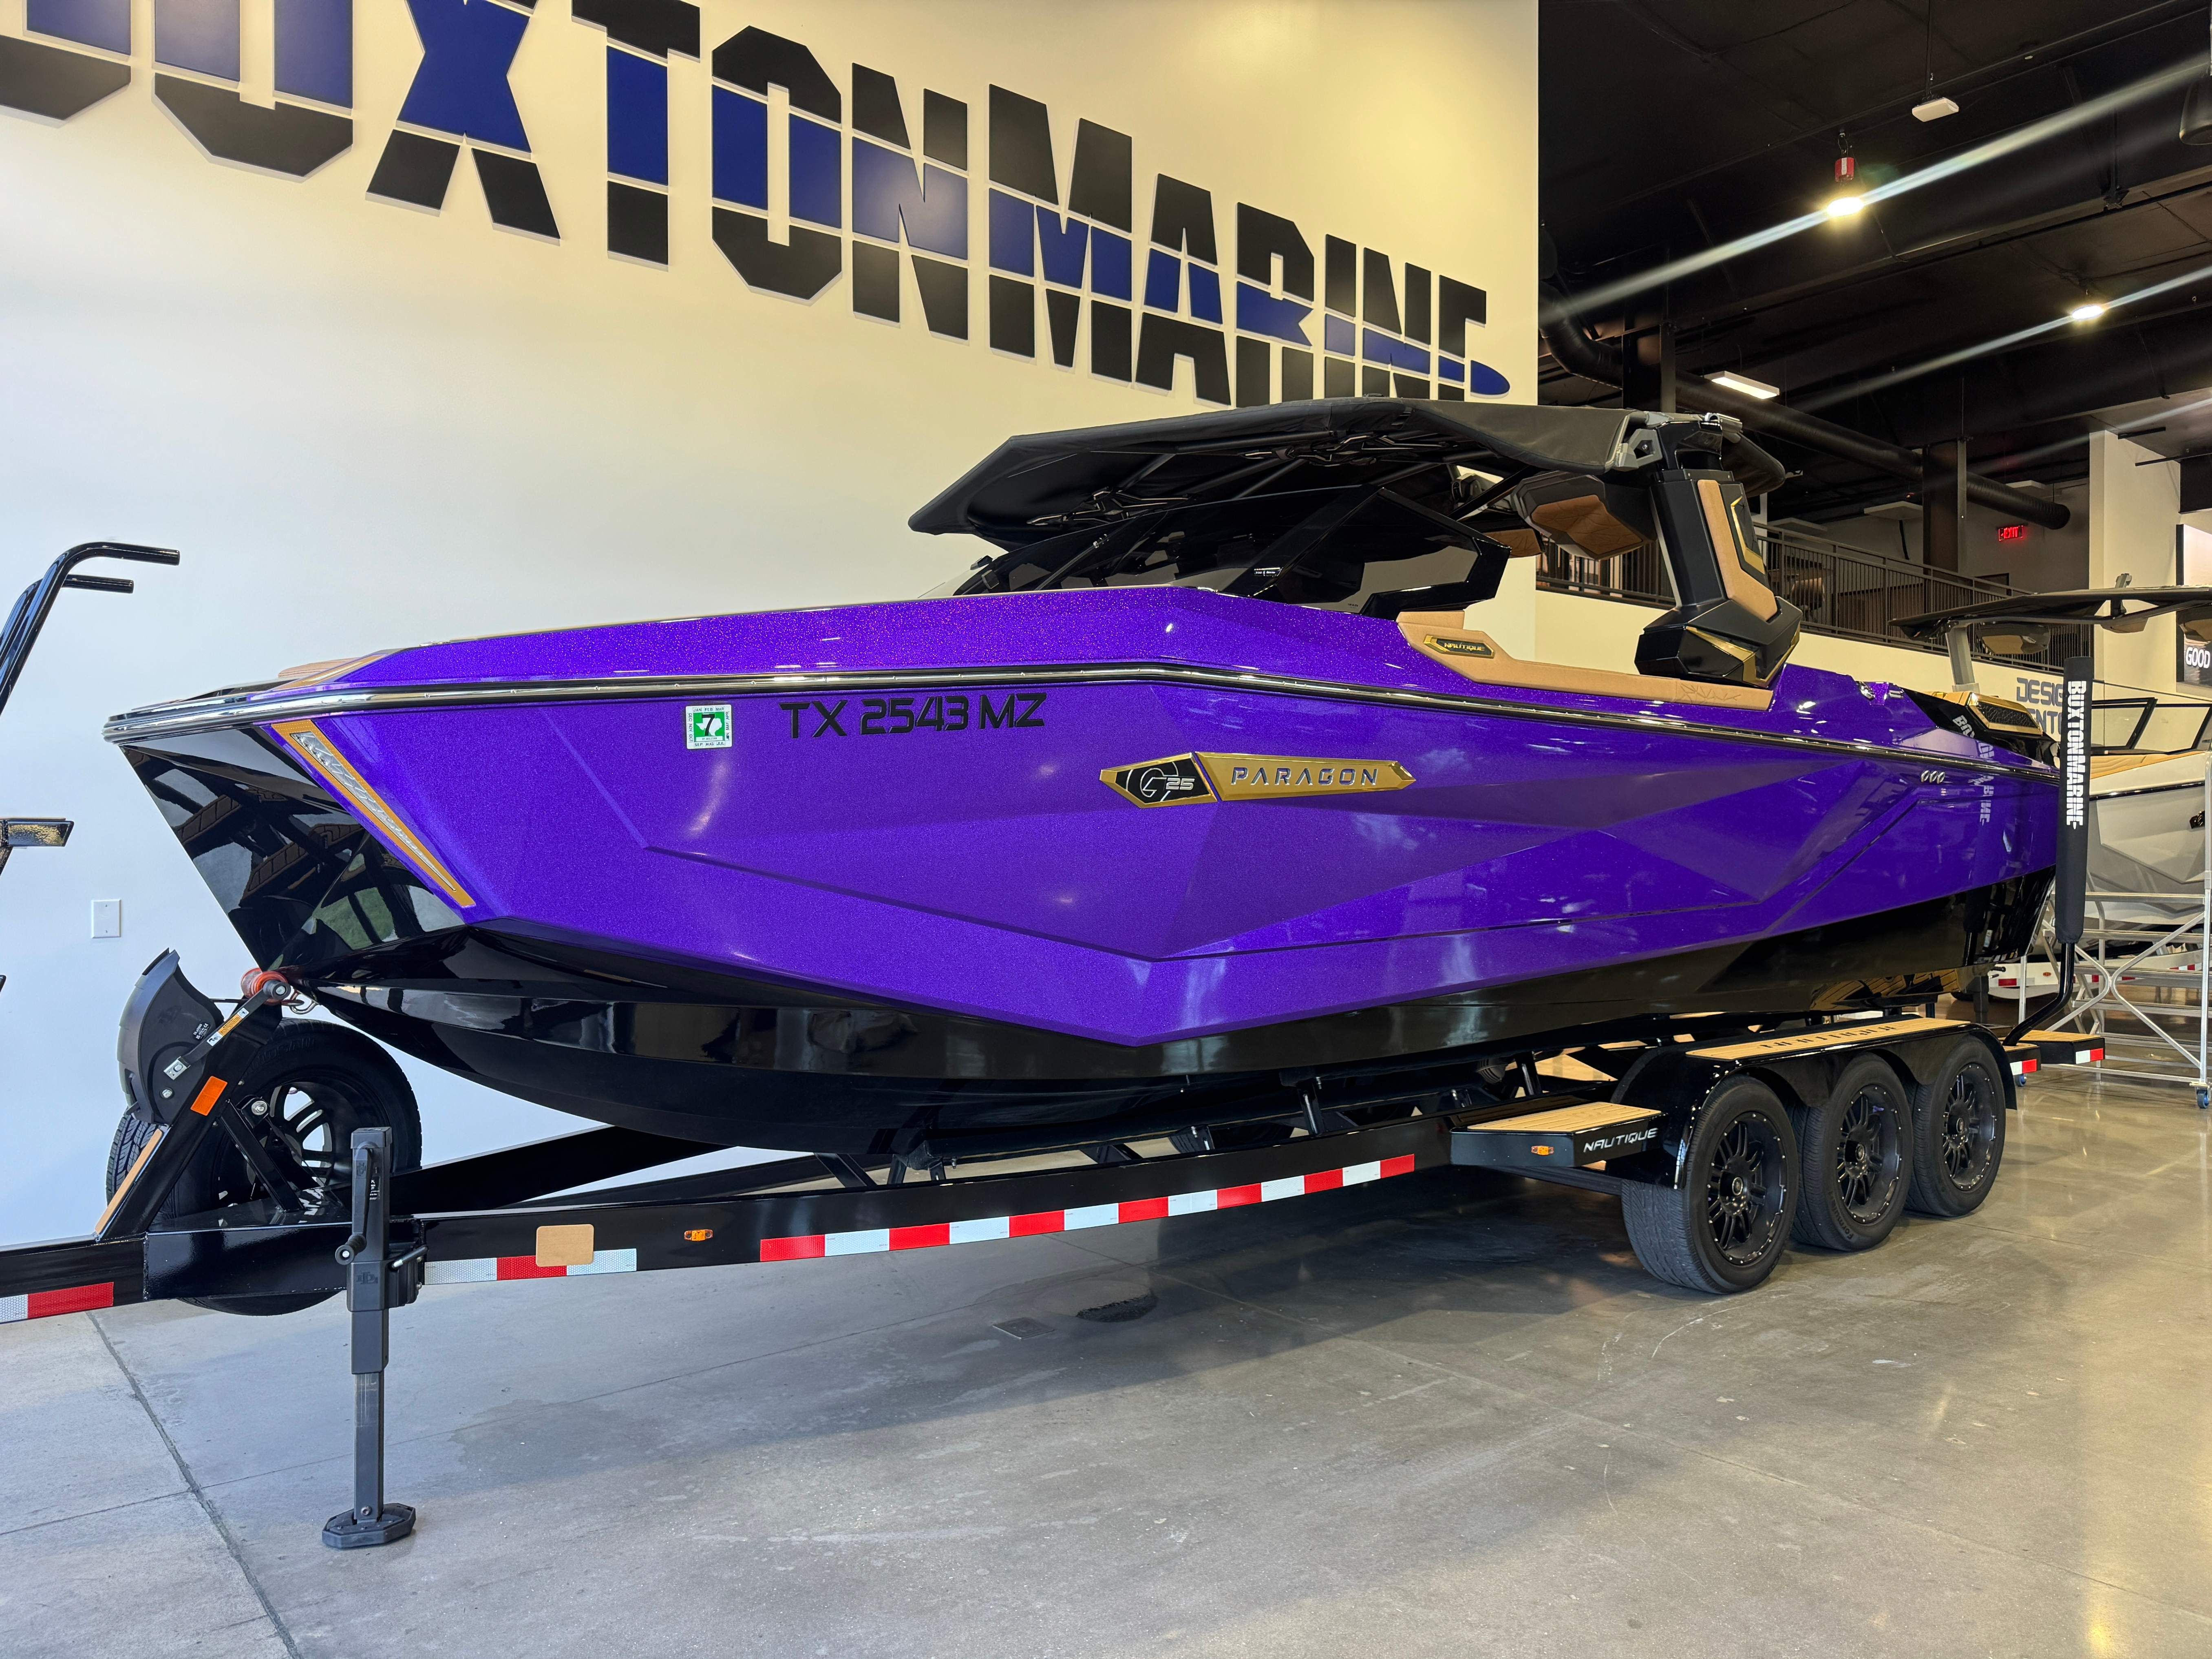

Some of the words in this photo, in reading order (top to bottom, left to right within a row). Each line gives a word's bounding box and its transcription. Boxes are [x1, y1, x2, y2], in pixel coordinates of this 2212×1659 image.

[1444, 642, 1485, 651] NAUTIQUE
[2186, 647, 2210, 668] GOOD
[702, 714, 715, 736] 7
[779, 700, 848, 738] TX
[860, 696, 969, 735] 2543
[979, 693, 1047, 729] MZ
[2066, 680, 2087, 830] BUXTONMARINE
[1231, 767, 1379, 786] PARAGON
[1583, 1127, 1658, 1153] NAUTIQUE
